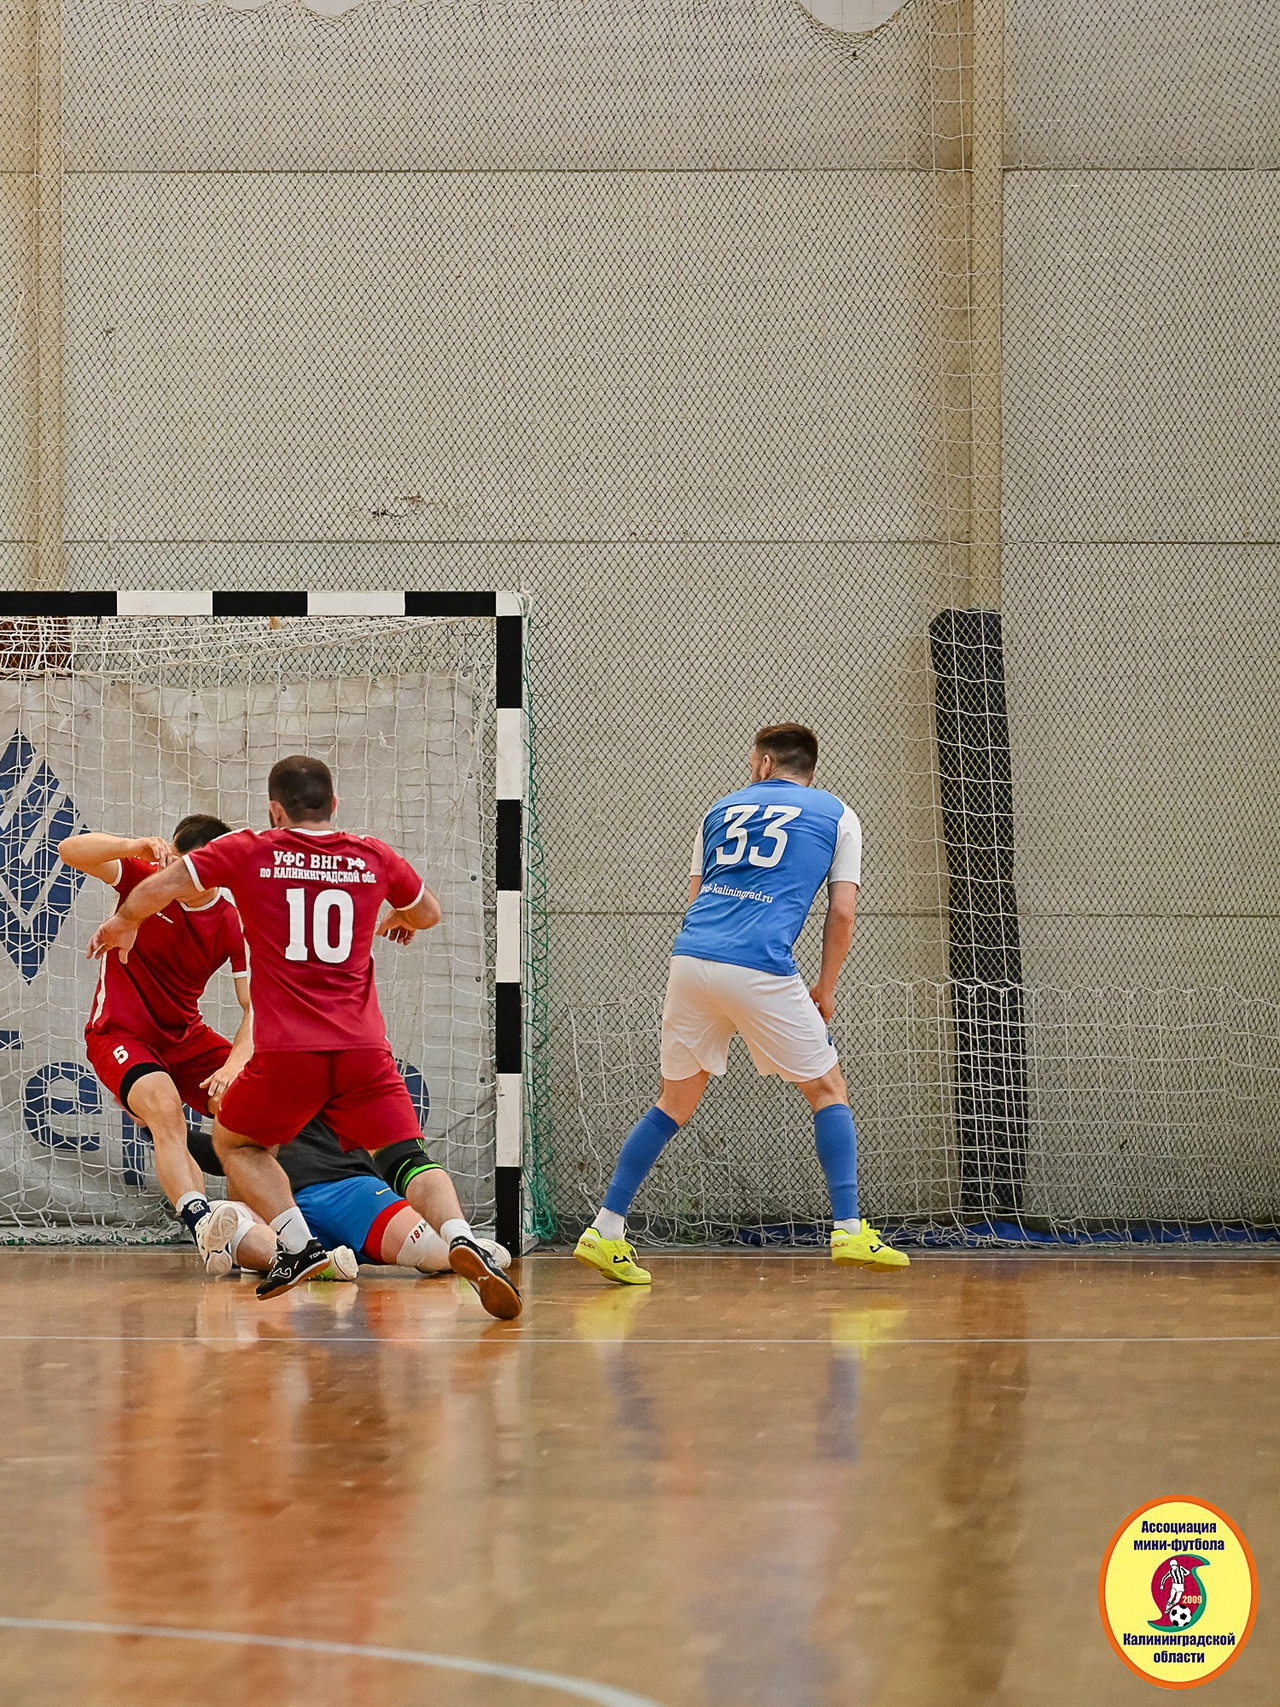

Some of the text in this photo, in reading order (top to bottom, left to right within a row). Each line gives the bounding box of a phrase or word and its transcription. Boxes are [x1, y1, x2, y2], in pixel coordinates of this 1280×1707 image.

[715, 804, 803, 868] 33
[273, 850, 366, 871] УФС ВНГ РФ
[259, 867, 271, 878] по
[273, 867, 360, 884] КАЛИНИНГРАДСКОЙ
[285, 887, 354, 964] 10
[112, 1045, 129, 1064] 5
